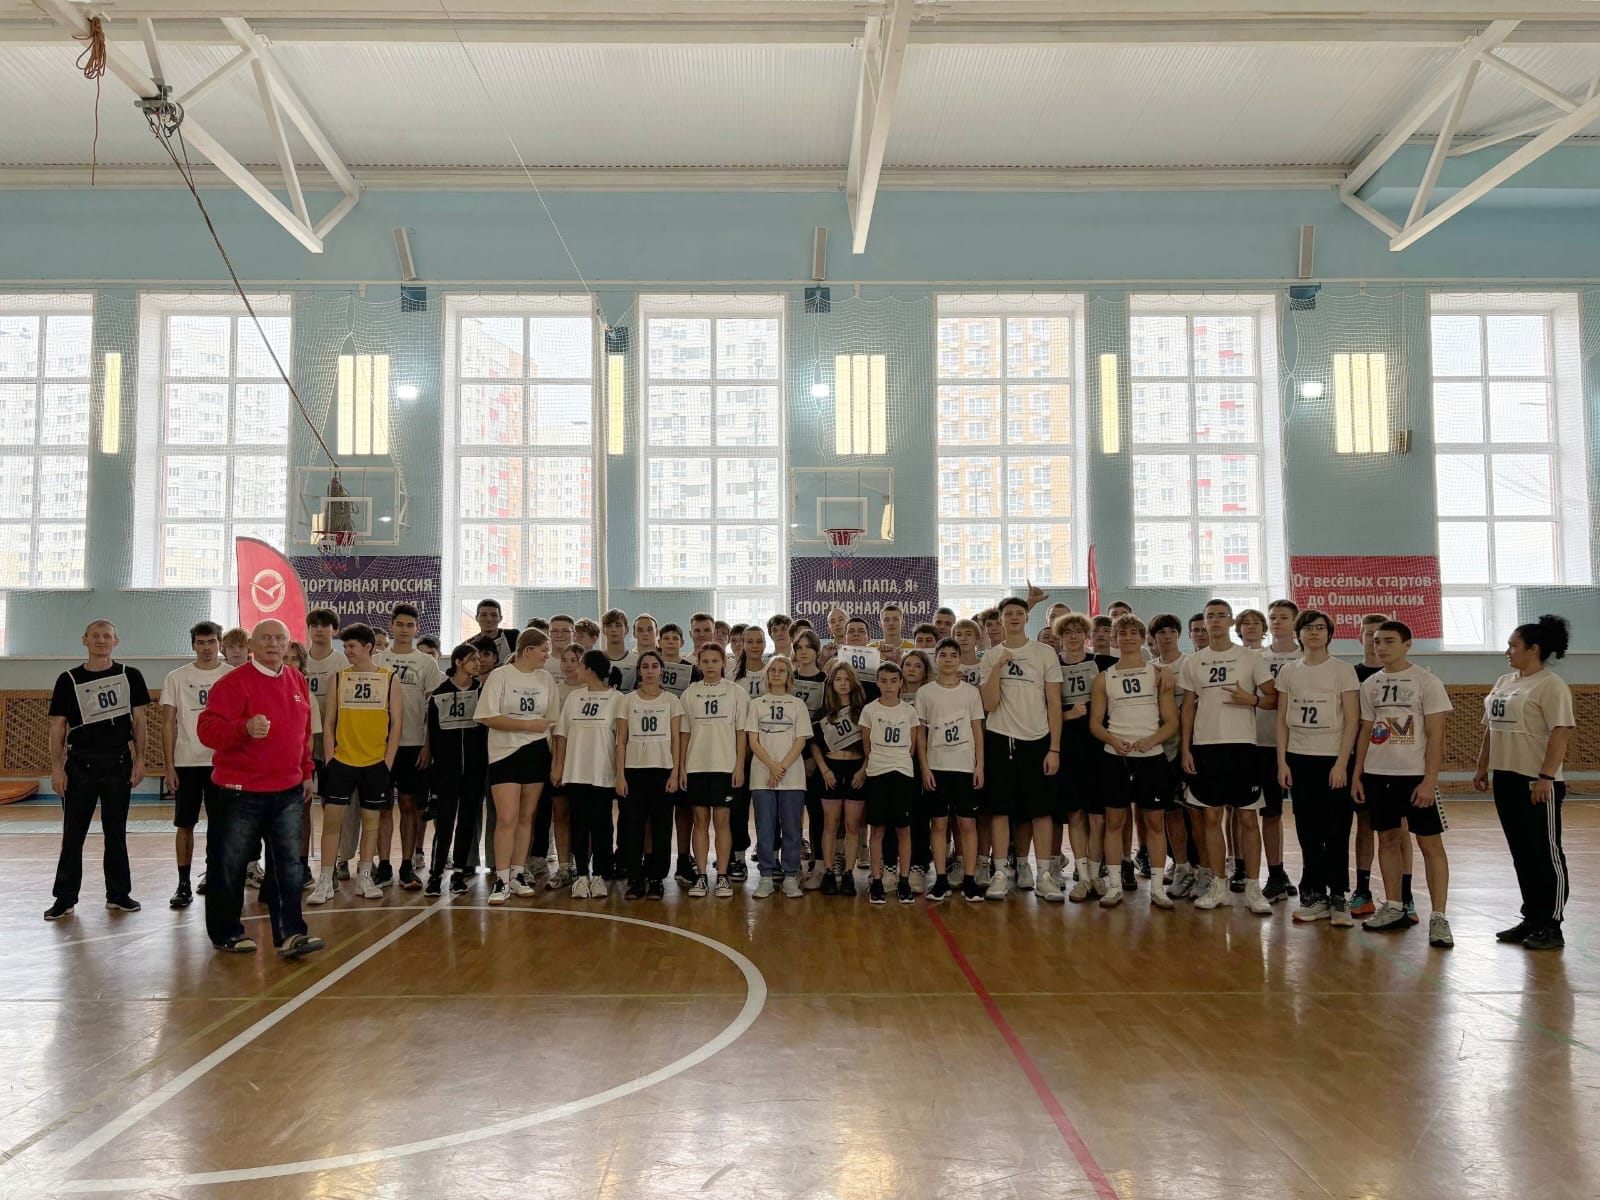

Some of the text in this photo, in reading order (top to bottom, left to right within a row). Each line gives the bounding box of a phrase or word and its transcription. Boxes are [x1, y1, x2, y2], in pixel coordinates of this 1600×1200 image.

[301, 578, 379, 593] ПОРТИВНАЯ
[1294, 574, 1310, 587] От
[1314, 573, 1373, 587] весёлых
[1307, 591, 1424, 608] до Олимпийских
[308, 601, 364, 615] ИЛЬНАЯ
[368, 601, 418, 615] РОС
[851, 655, 866, 670] 69
[1209, 667, 1227, 683] 29
[354, 683, 371, 699] 25
[1068, 676, 1086, 693] 75
[1122, 678, 1141, 694] 03
[97, 690, 118, 709] 60
[1382, 685, 1398, 702] 71
[449, 702, 465, 717] 43
[519, 697, 535, 712] 83
[704, 700, 718, 715] 16
[769, 705, 784, 720] 13
[1491, 698, 1505, 717] 85
[1301, 706, 1318, 724] 72
[641, 716, 658, 732] 08
[835, 718, 852, 737] 50
[884, 727, 900, 743] 06
[945, 726, 960, 743] 62
